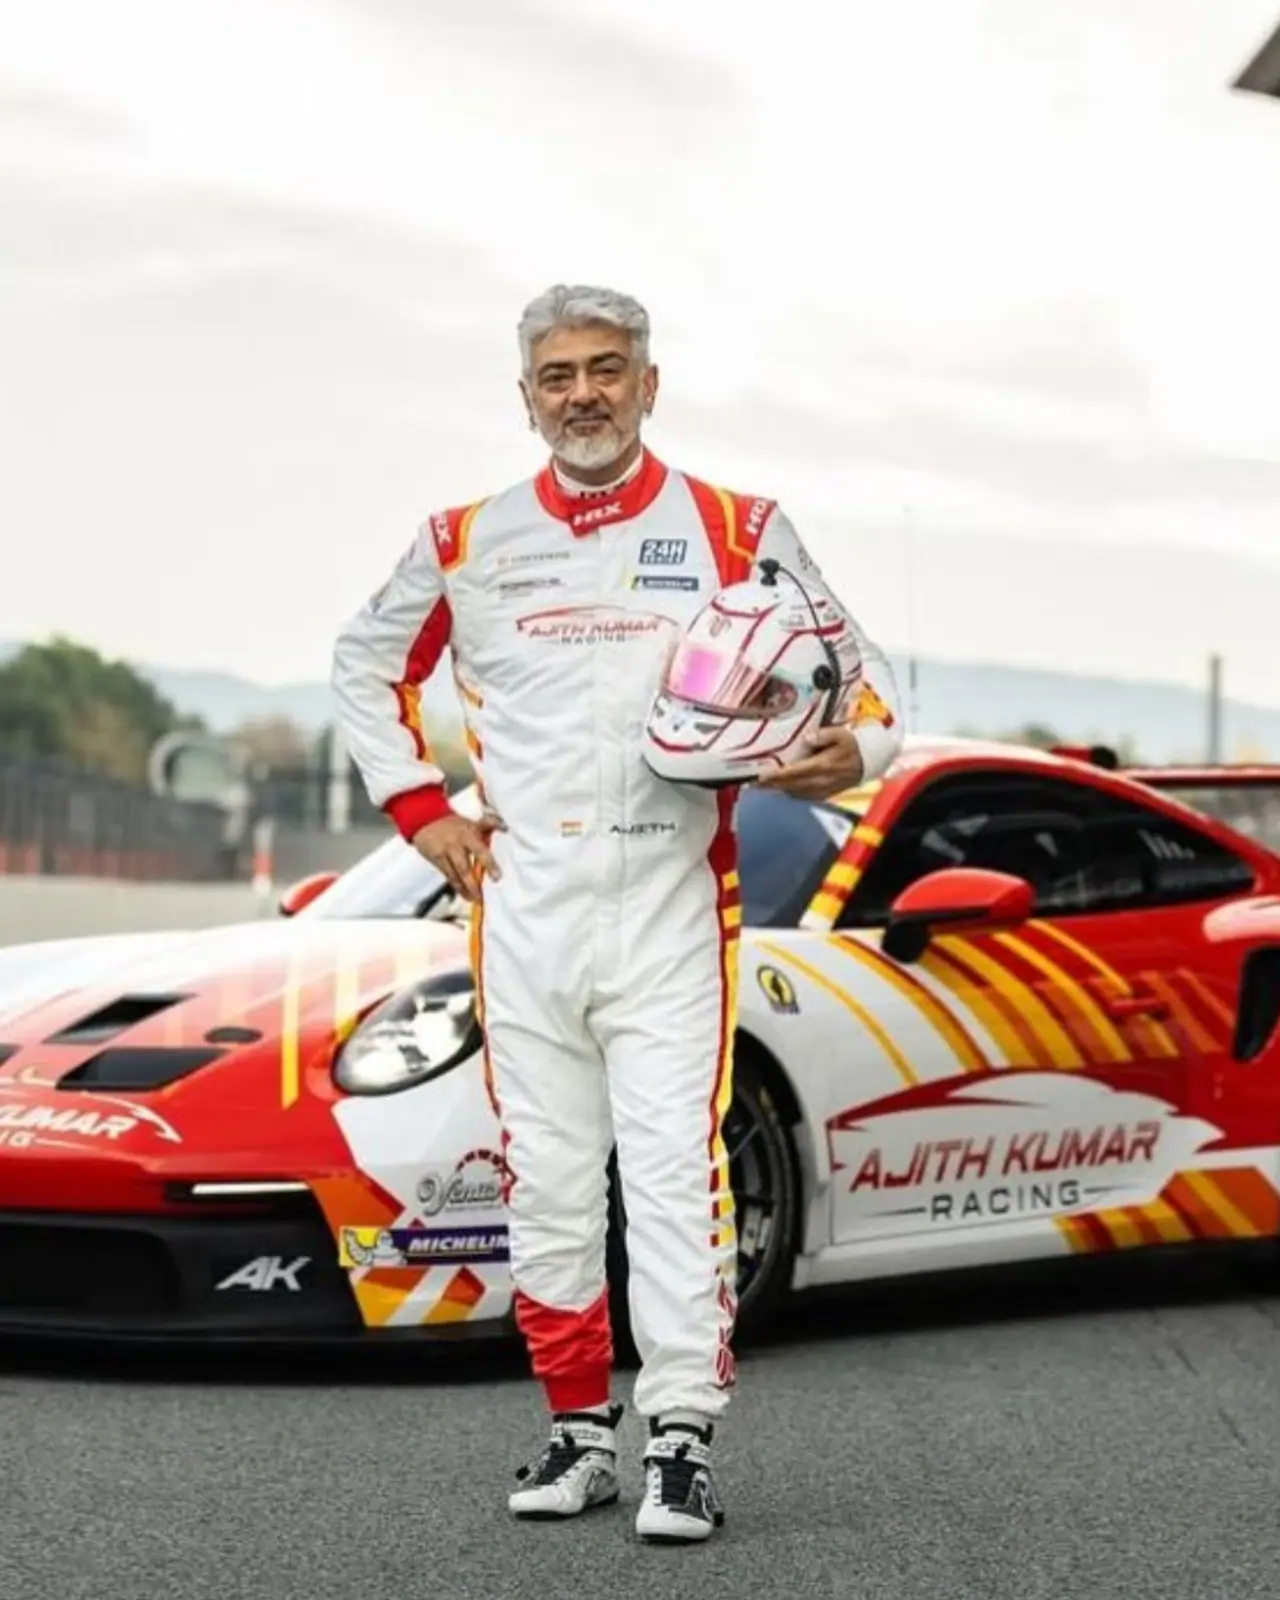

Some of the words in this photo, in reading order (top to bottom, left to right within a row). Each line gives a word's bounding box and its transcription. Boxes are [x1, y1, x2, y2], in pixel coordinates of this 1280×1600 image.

[849, 1134, 997, 1194] AJITH
[1001, 1120, 1163, 1177] KUMAR
[930, 1179, 1083, 1222] RACING
[215, 1255, 312, 1291] AK
